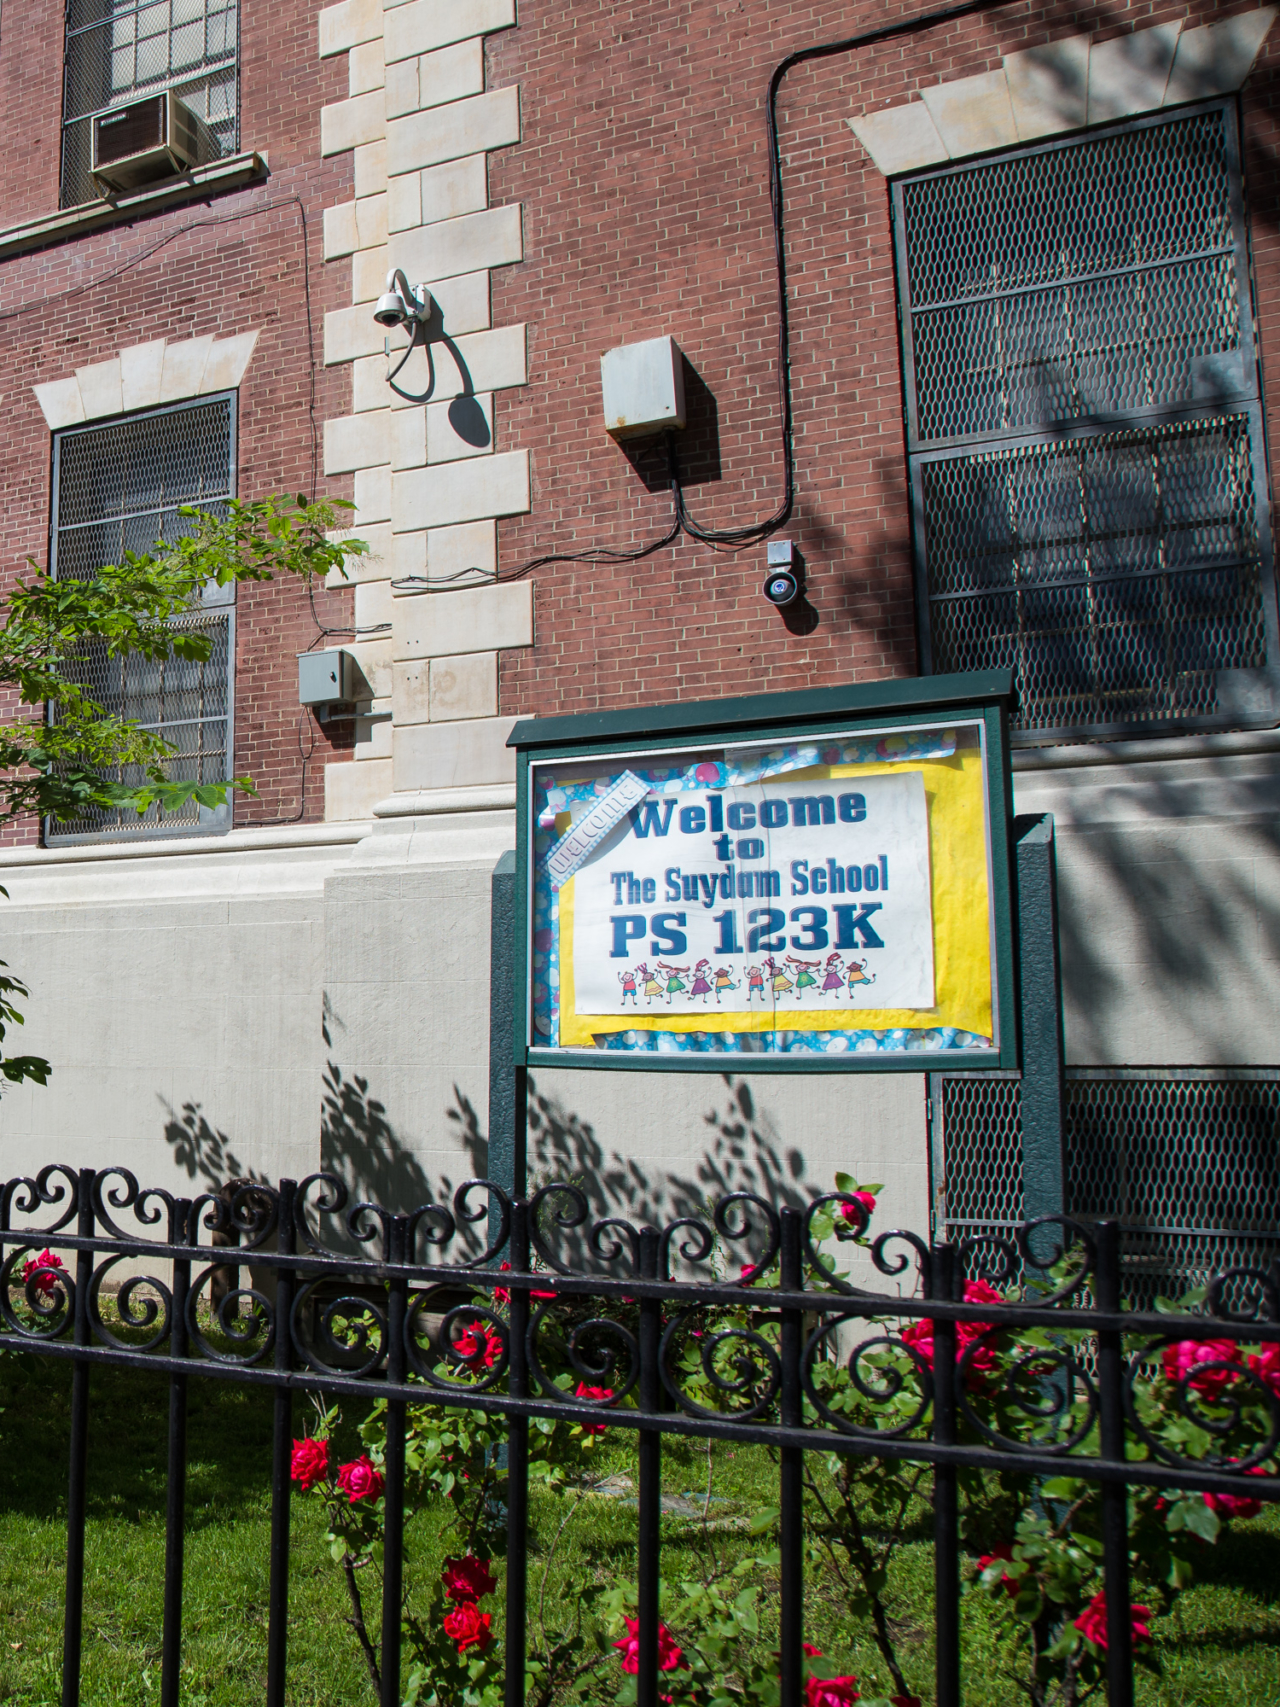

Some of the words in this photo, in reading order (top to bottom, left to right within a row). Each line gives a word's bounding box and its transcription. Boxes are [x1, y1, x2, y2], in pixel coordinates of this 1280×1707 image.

[627, 792, 867, 839] Welcome
[713, 833, 765, 861] to
[610, 871, 656, 905] The
[664, 863, 780, 909] Suydam
[790, 854, 889, 896] School
[609, 911, 688, 958] PS
[712, 902, 885, 954] 123K
